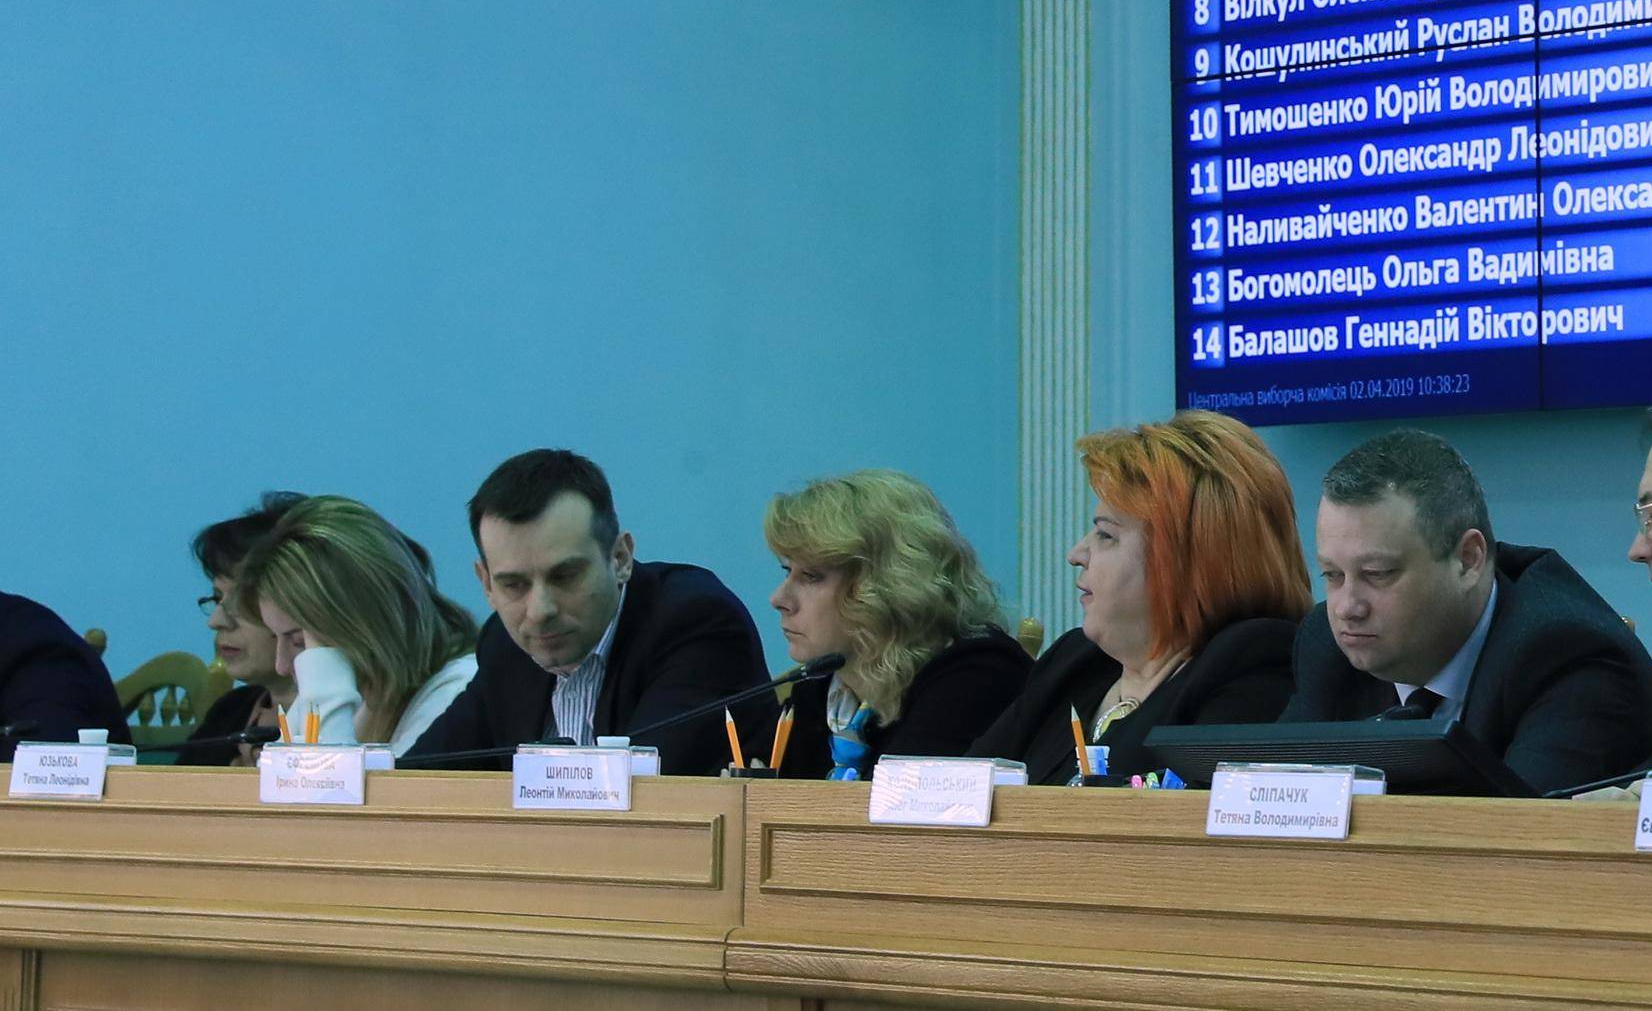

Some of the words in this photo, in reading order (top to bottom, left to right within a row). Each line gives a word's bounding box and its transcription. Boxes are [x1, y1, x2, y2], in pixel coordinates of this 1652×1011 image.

[1194, 49, 1210, 81] 9
[1224, 18, 1410, 81] Кошулинський
[1417, 14, 1509, 61] Руслан
[1189, 106, 1218, 141] 10
[1223, 96, 1368, 136] Тимошенко
[1374, 76, 1441, 124] Юрій
[1190, 160, 1218, 195] 11
[1225, 153, 1352, 191] Шевченко
[1358, 136, 1501, 176] Олександр
[1190, 216, 1220, 250] 12
[1226, 203, 1408, 247] Наливайченко
[1414, 191, 1545, 229] Валентин
[1191, 270, 1220, 304] 13
[1227, 265, 1376, 301] Богомолець
[1382, 254, 1459, 288] Ольга
[1467, 239, 1614, 285] Вадимівна
[1192, 326, 1222, 360] 14
[1228, 324, 1339, 357] Балашов
[1344, 306, 1459, 350] Геннадій
[1467, 304, 1623, 345] Вікторович
[519, 785, 555, 800] Леонтій
[546, 766, 593, 780] ШИПІЛОВ
[1249, 787, 1309, 803] СЛІПАЧУК
[1214, 809, 1251, 824] Тетяна
[1253, 810, 1339, 829] Володимирівна
